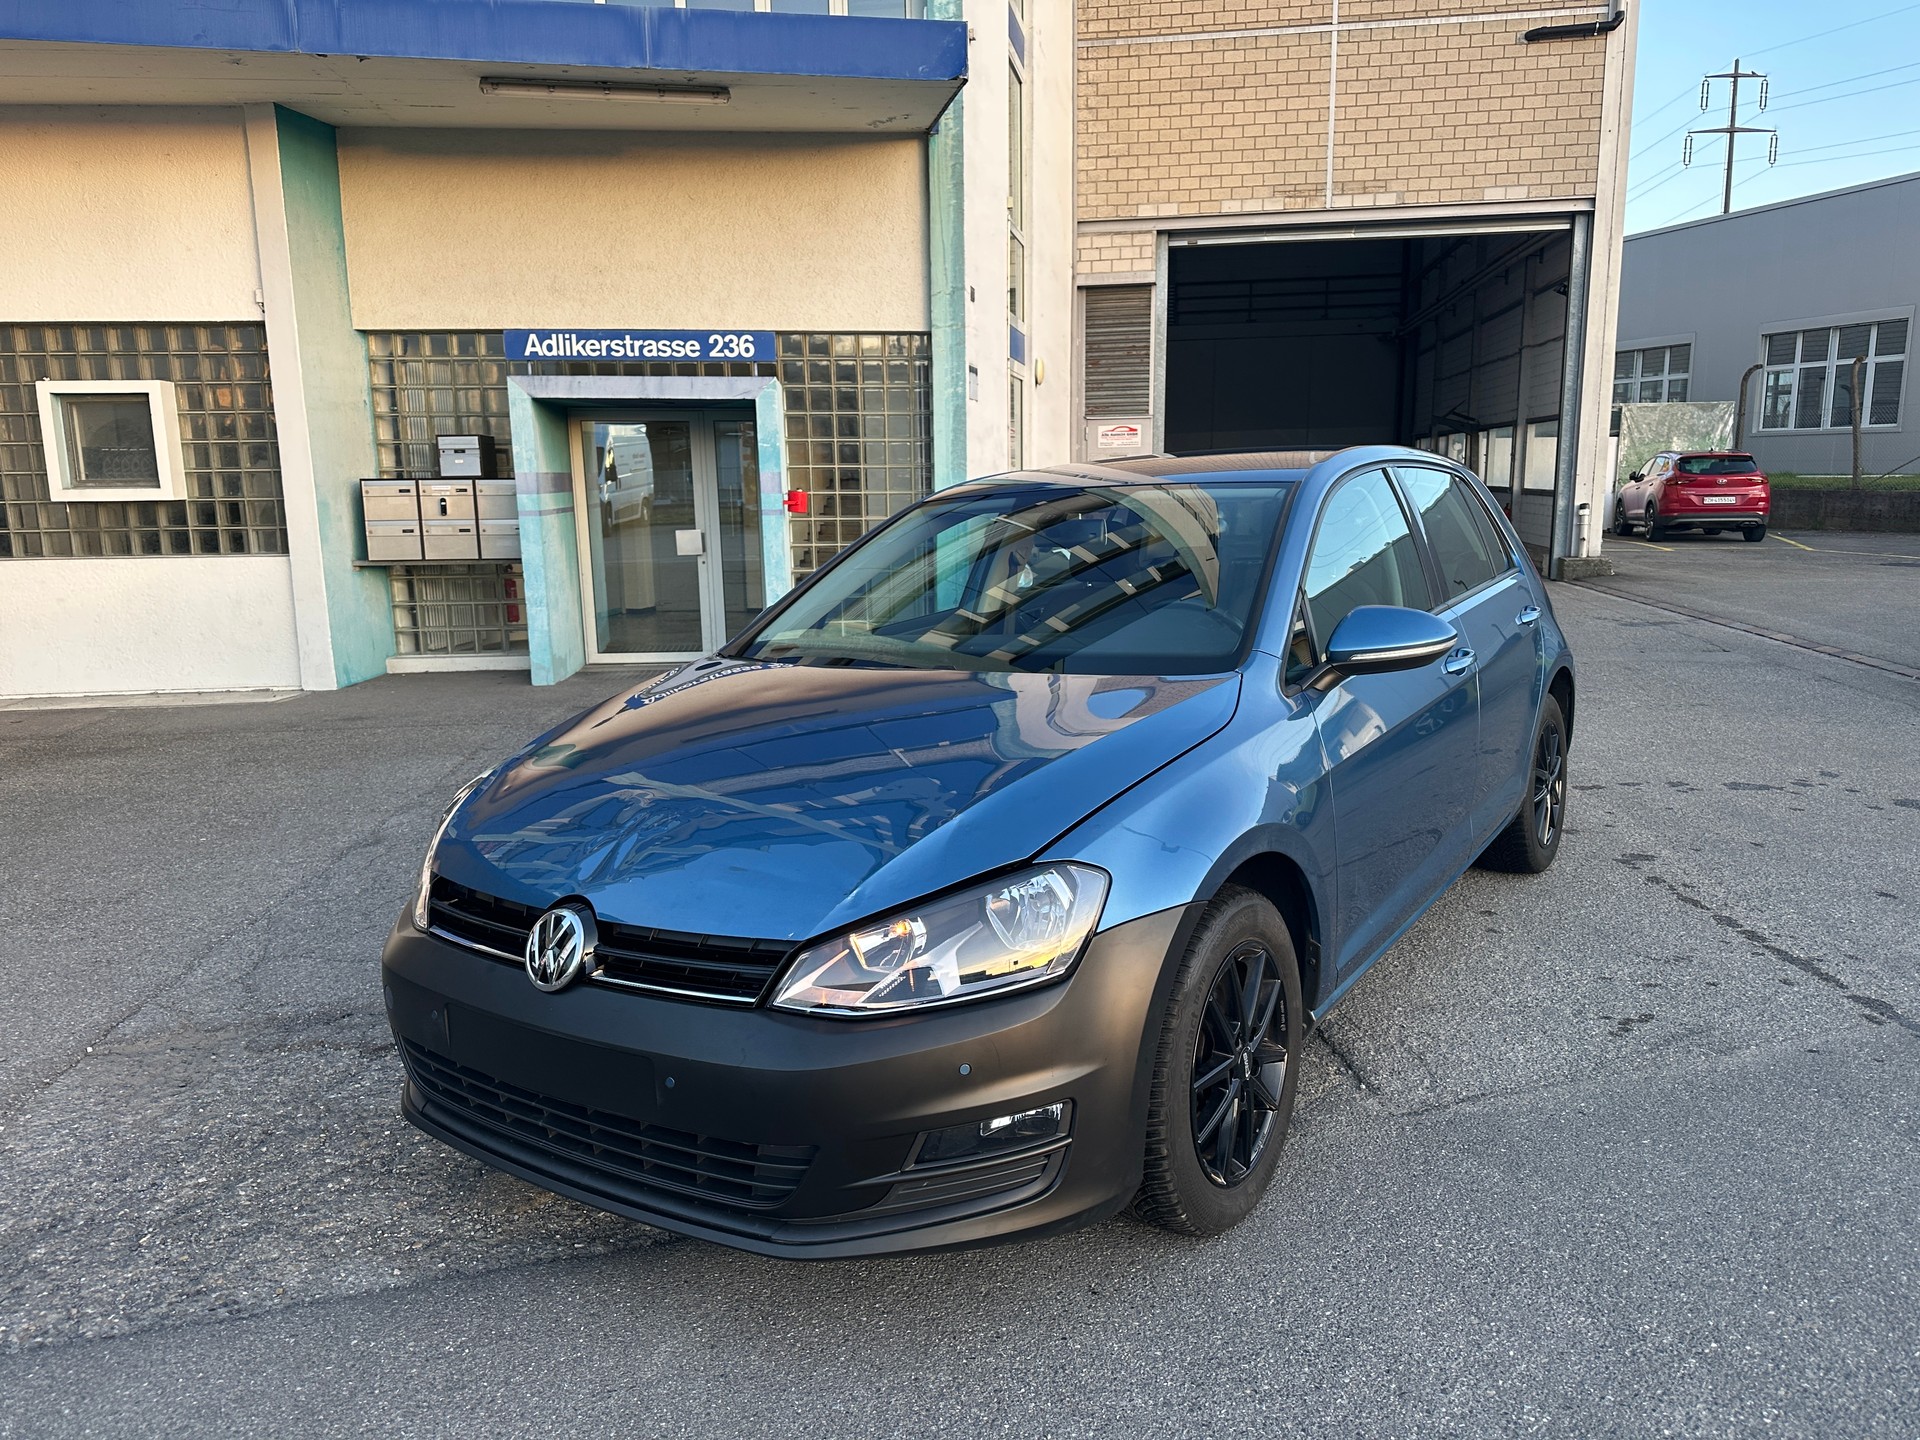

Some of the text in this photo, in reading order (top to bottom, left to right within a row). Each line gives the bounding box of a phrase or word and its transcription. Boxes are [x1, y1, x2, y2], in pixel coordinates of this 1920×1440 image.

[524, 333, 755, 358] Adlikerstrasse 236
[527, 910, 582, 989] VW
